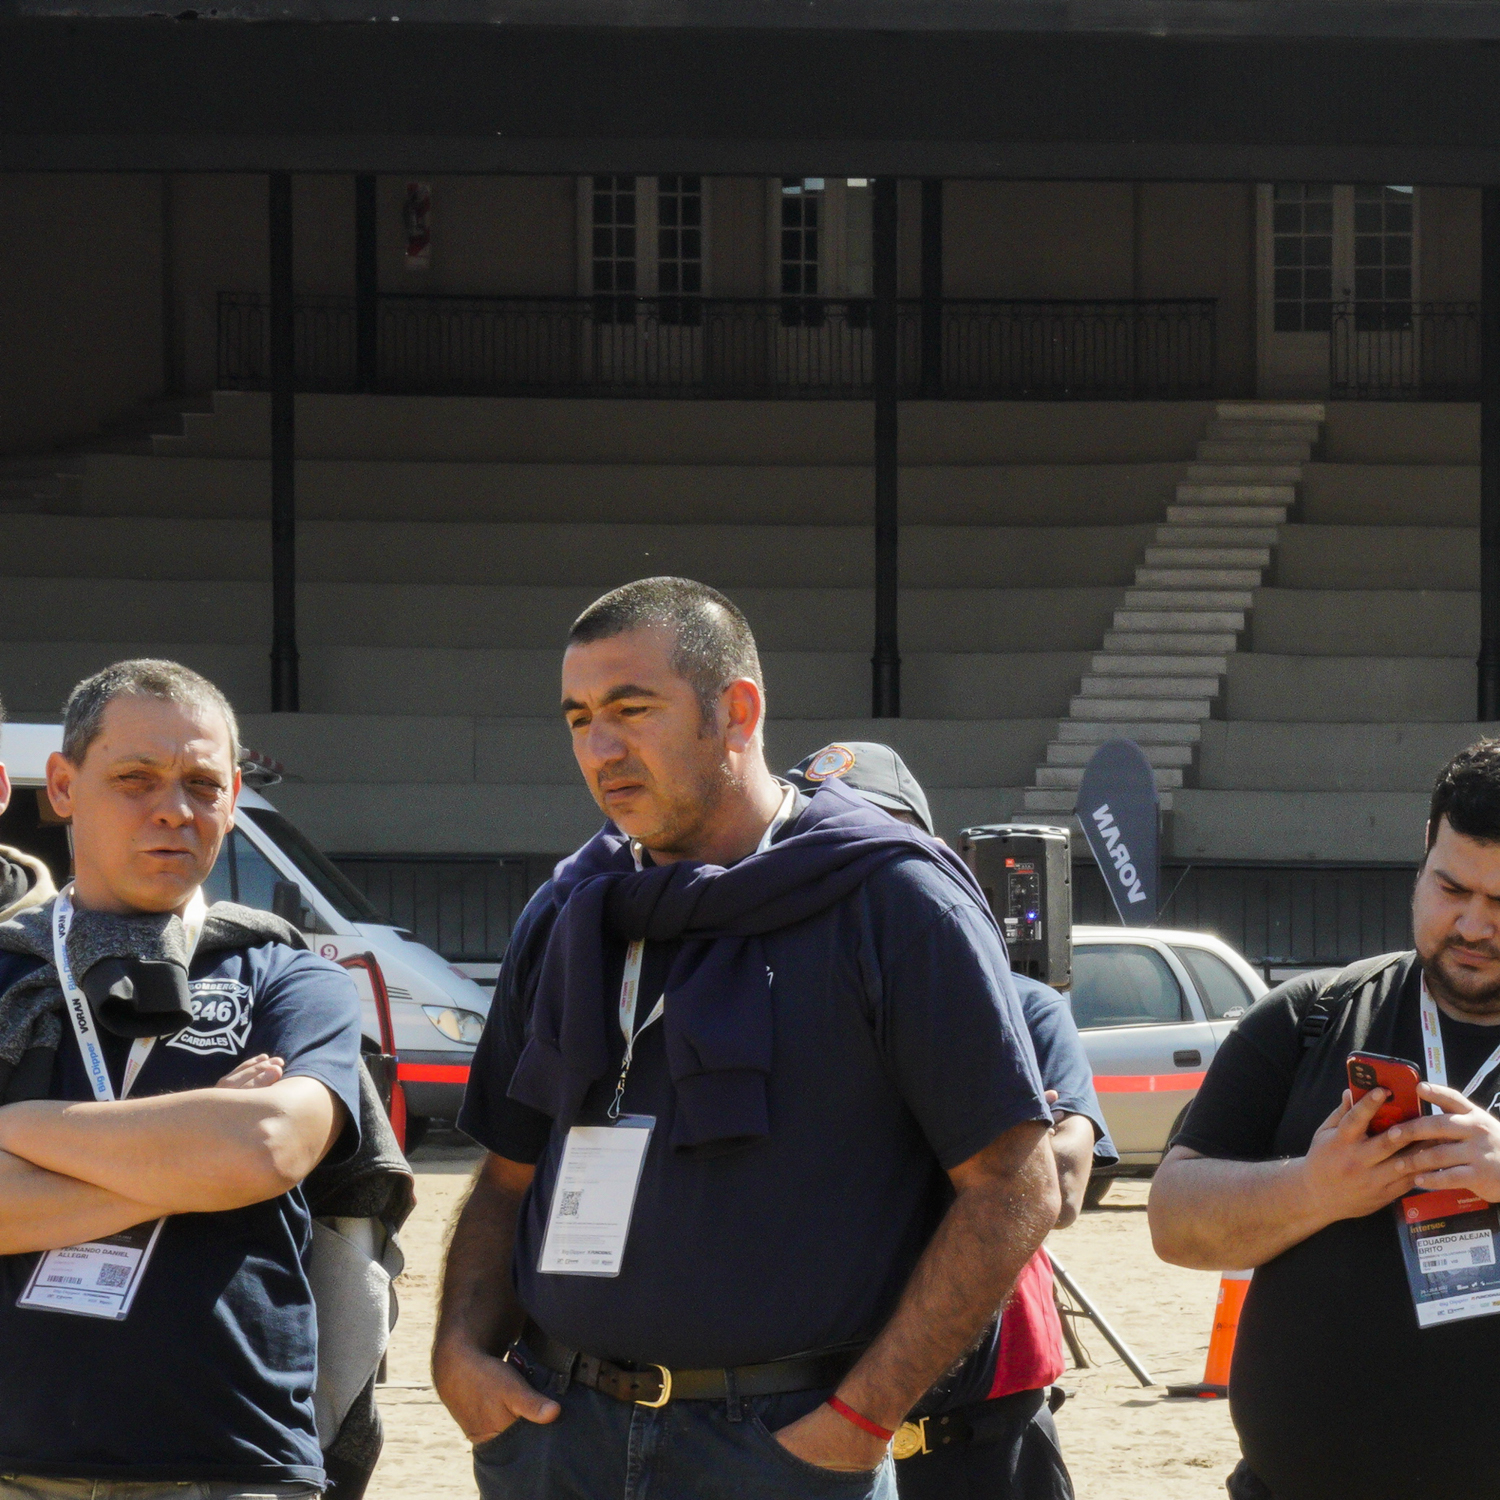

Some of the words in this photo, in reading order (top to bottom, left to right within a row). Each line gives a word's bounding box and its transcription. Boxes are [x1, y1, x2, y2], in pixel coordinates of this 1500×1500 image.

[72, 997, 90, 1035] VORAN
[192, 1000, 233, 1022] 246
[180, 1034, 229, 1048] CARDALES
[86, 1042, 105, 1074] Dipper
[97, 1073, 107, 1094] Big
[1410, 1220, 1446, 1234] intersec
[1417, 1235, 1458, 1248] EDUARDO
[1459, 1231, 1491, 1242] ALEJAN
[57, 1251, 89, 1260] ALLEGRI
[101, 1249, 130, 1258] DANIEL
[1418, 1245, 1443, 1255] BRITO
